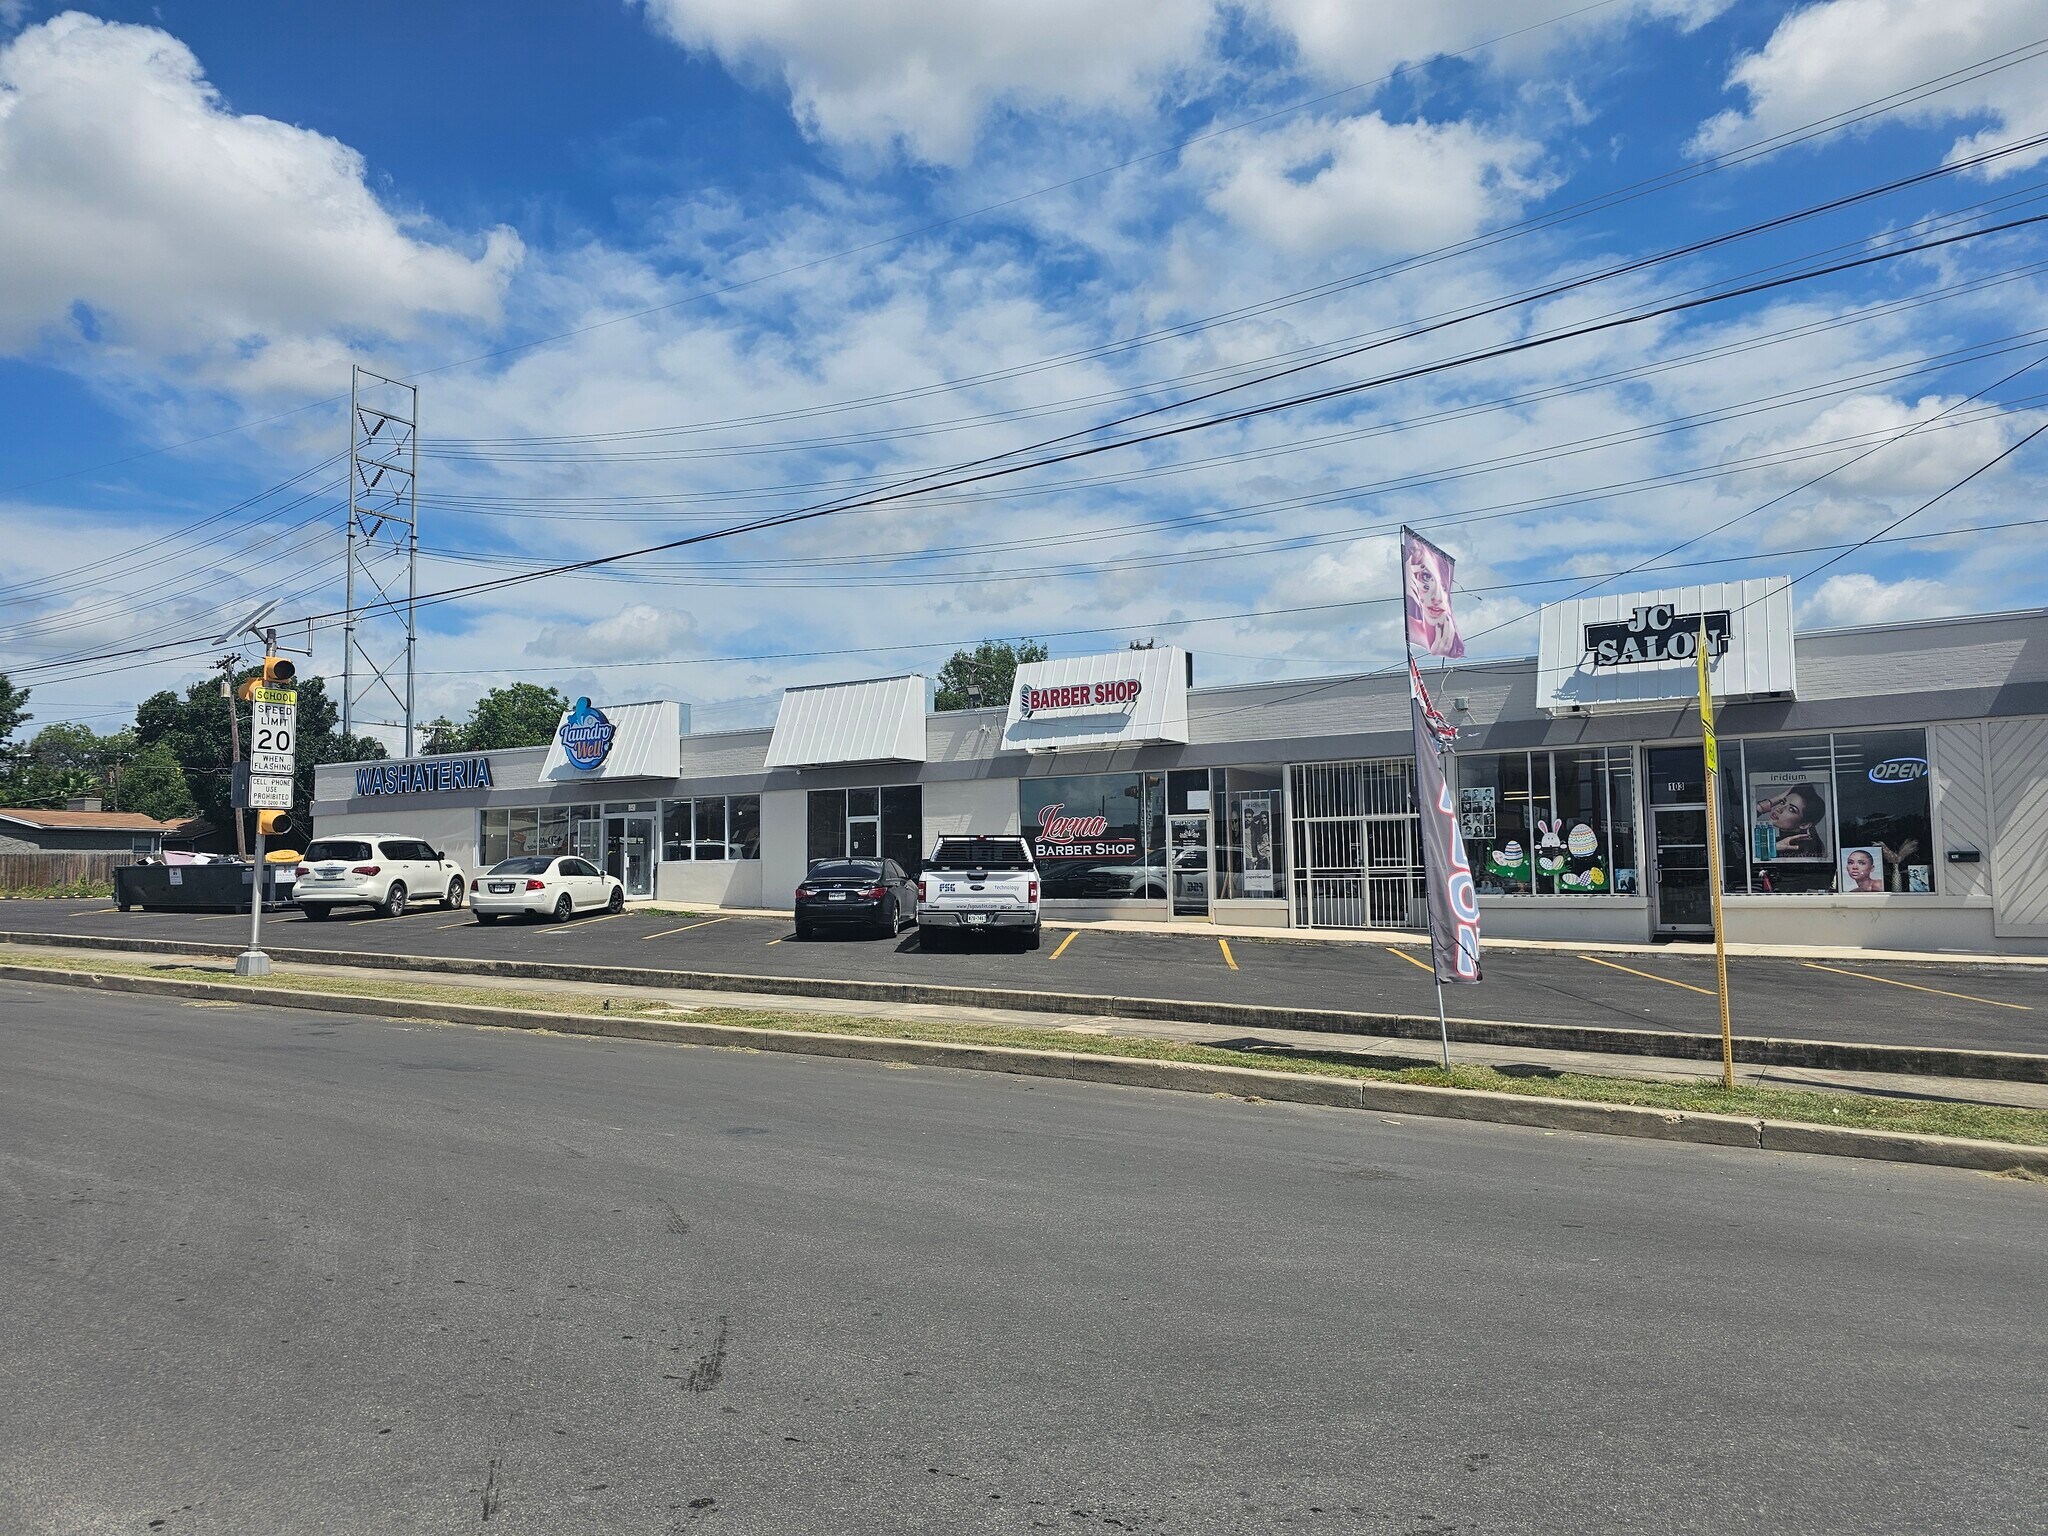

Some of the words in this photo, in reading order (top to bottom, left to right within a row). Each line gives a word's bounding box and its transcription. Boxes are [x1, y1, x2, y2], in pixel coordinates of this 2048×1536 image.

[1628, 604, 1674, 633] JC
[1598, 629, 1720, 666] SALON
[257, 690, 294, 702] SCHOOL
[1031, 685, 1090, 709] BARBER
[1094, 681, 1138, 704] SHOP
[257, 704, 292, 716] SPEED
[261, 716, 288, 726] LIMIT
[258, 729, 290, 751] 20
[560, 721, 611, 747] Laundro
[574, 740, 603, 760] Well
[263, 755, 284, 763] WHEN
[254, 762, 291, 771] FLASHING
[1873, 763, 1924, 779] OPEN
[271, 779, 291, 787] PHONE
[355, 757, 493, 796] WASHATERIA
[1770, 773, 1807, 782] iridium
[1668, 782, 1685, 792] 103
[253, 792, 289, 801] PROHIBITED
[1035, 803, 1108, 845] Lerma
[1036, 844, 1092, 856] BARBER
[1095, 842, 1135, 855] SHOP
[939, 883, 956, 892] FSG
[994, 884, 1021, 892] technology
